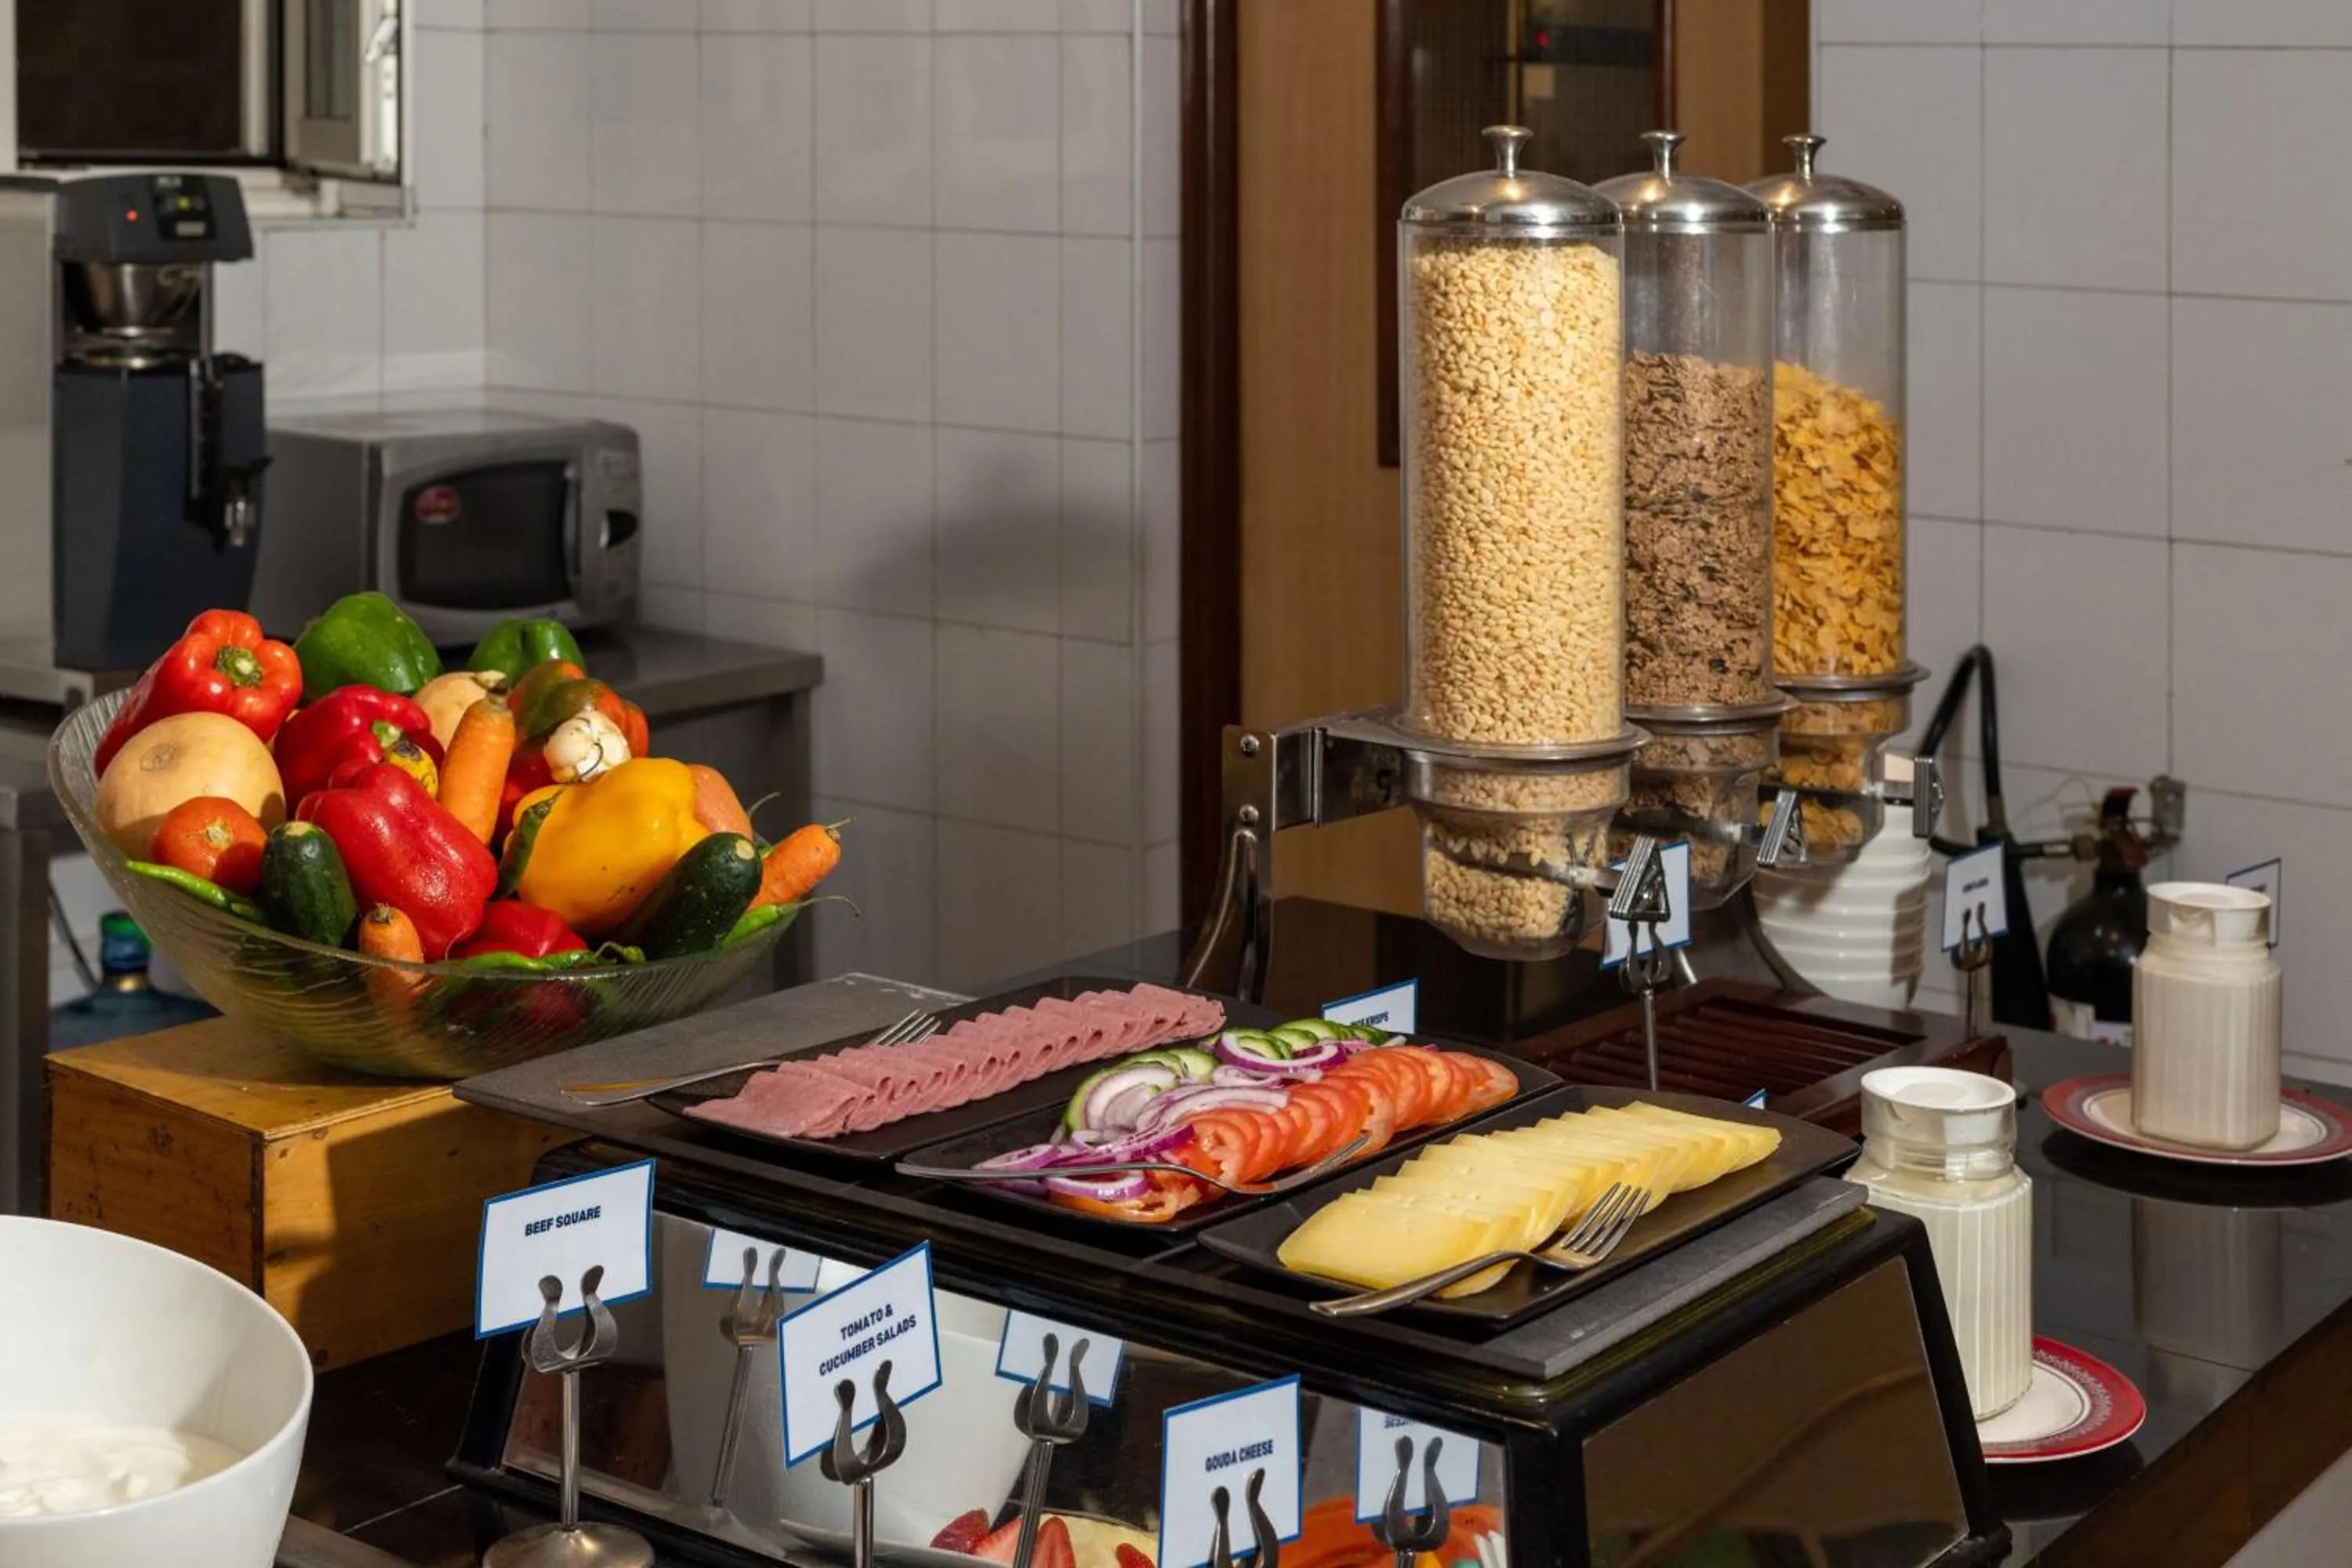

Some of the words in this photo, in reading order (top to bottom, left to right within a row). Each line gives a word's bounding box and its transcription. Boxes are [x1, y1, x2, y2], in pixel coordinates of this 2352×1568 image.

[525, 1217, 554, 1236] BEEF
[556, 1206, 601, 1229] SQUARE
[840, 1308, 884, 1341] TOMATO
[885, 1304, 893, 1318] &
[819, 1336, 876, 1376] CUCUMBER
[876, 1314, 916, 1346] SALADS
[1205, 1450, 1238, 1472] GOUDA
[1240, 1439, 1273, 1463] CHEESE
